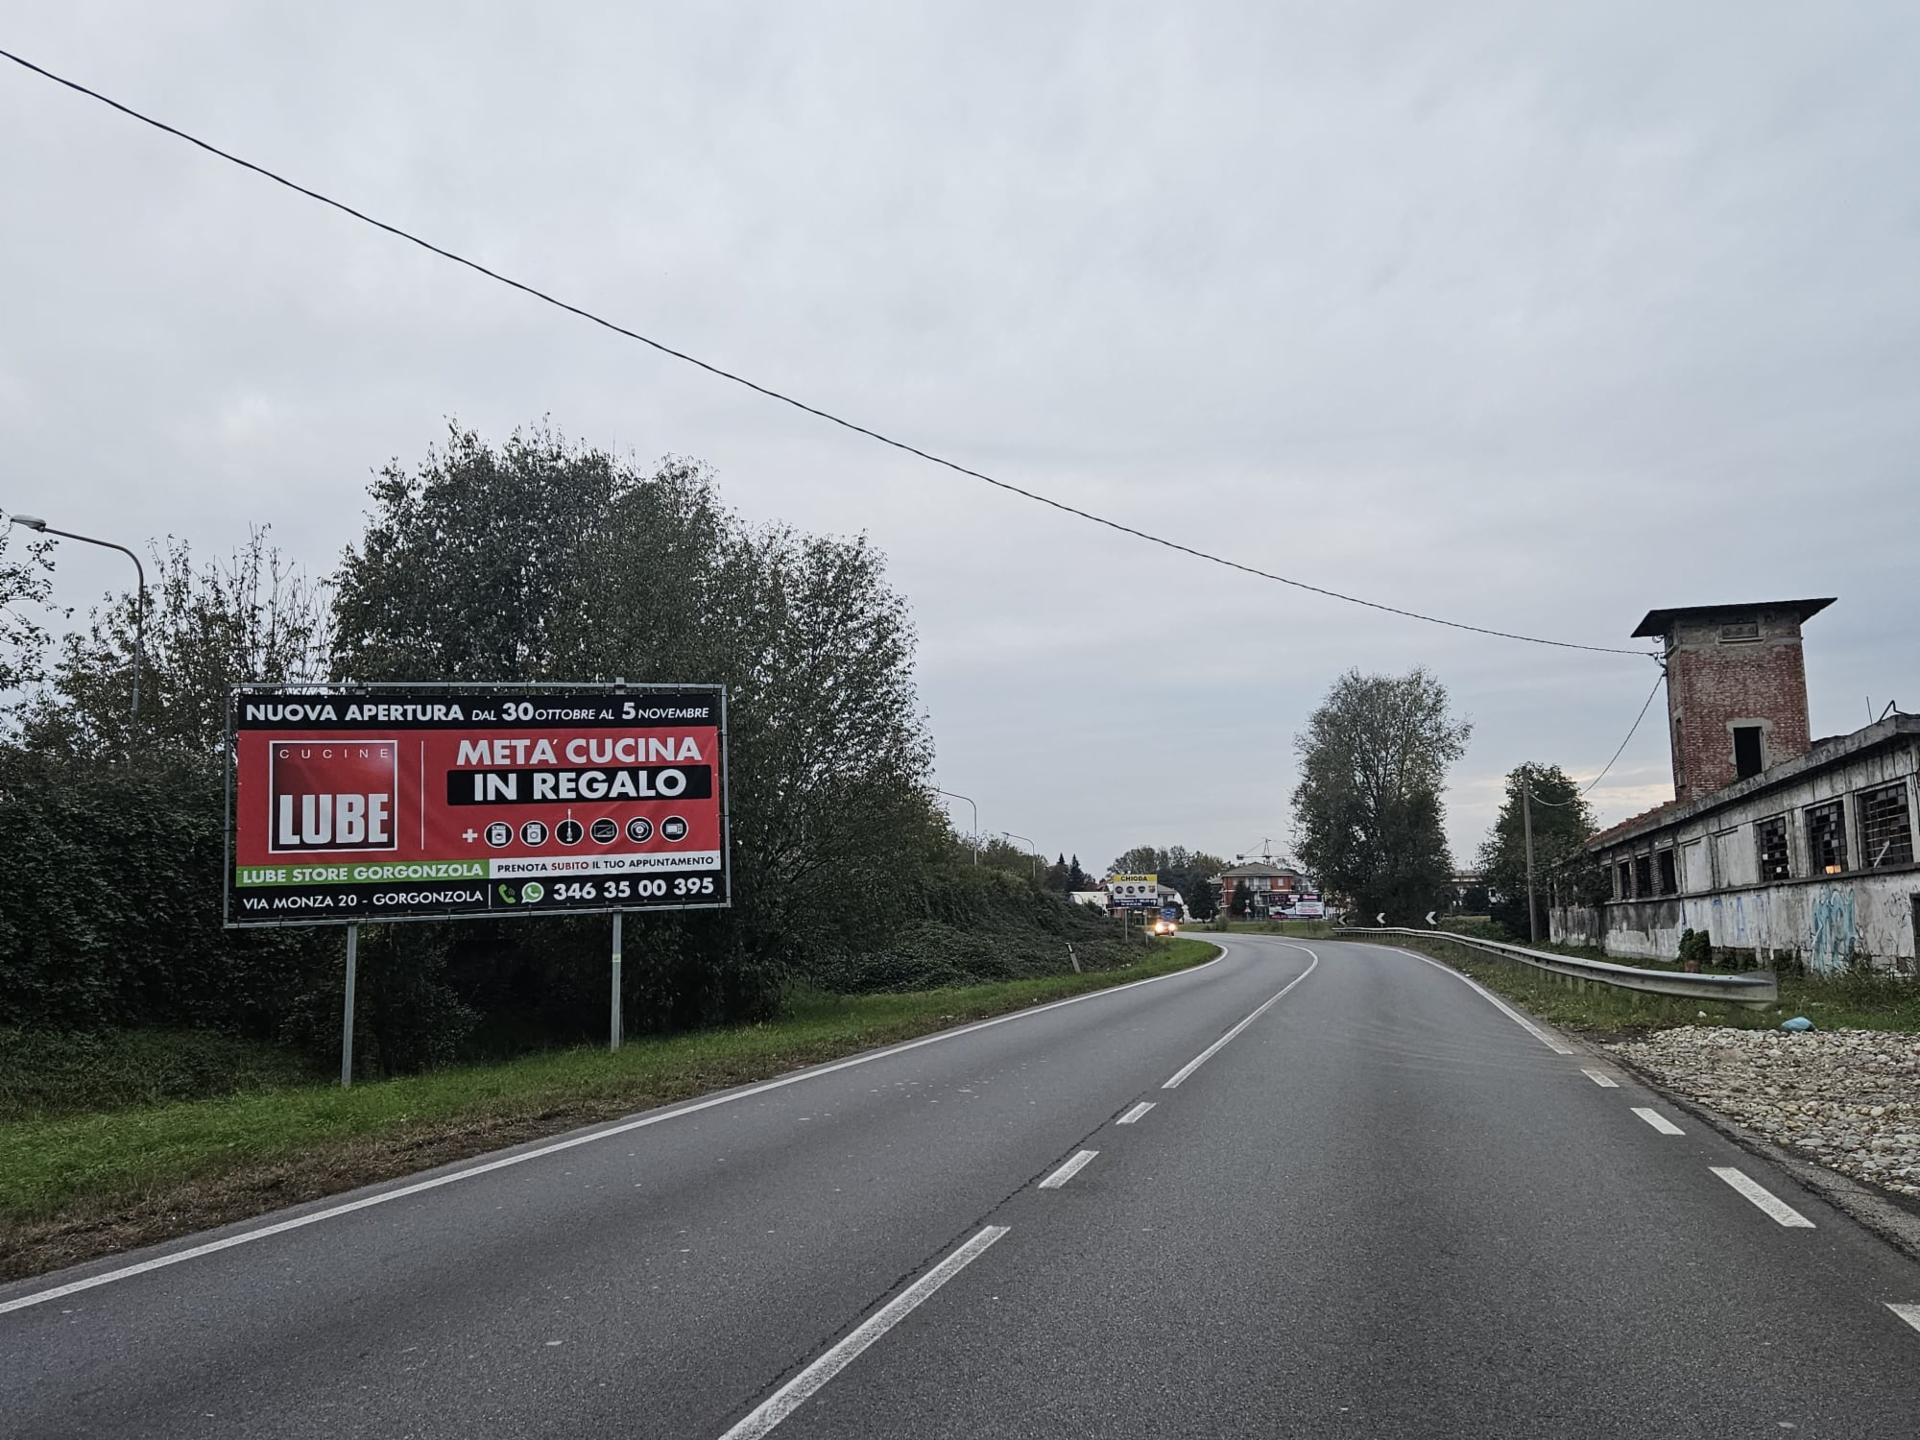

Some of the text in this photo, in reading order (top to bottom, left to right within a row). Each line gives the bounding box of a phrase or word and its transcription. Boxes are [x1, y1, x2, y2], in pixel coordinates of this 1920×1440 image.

[246, 702, 709, 721] NUOVA APERTURA DAL 30 OTTOBRE AL 5 NOVEMBRE
[279, 749, 389, 759] CUCINE
[565, 736, 702, 764] CUCINA
[474, 768, 687, 801] IN REGALO
[279, 793, 389, 845] LUBE
[242, 863, 483, 884] LUBE STORE GORGONZOLA
[497, 856, 714, 873] PRENOTA SUBITO IL TUO APPUNTAMENTO
[553, 877, 714, 900] 346 35 00 395
[243, 898, 269, 910] VIA
[273, 895, 334, 909] MONZA
[338, 895, 357, 907] 20
[372, 890, 483, 906] GORGONZOLA
